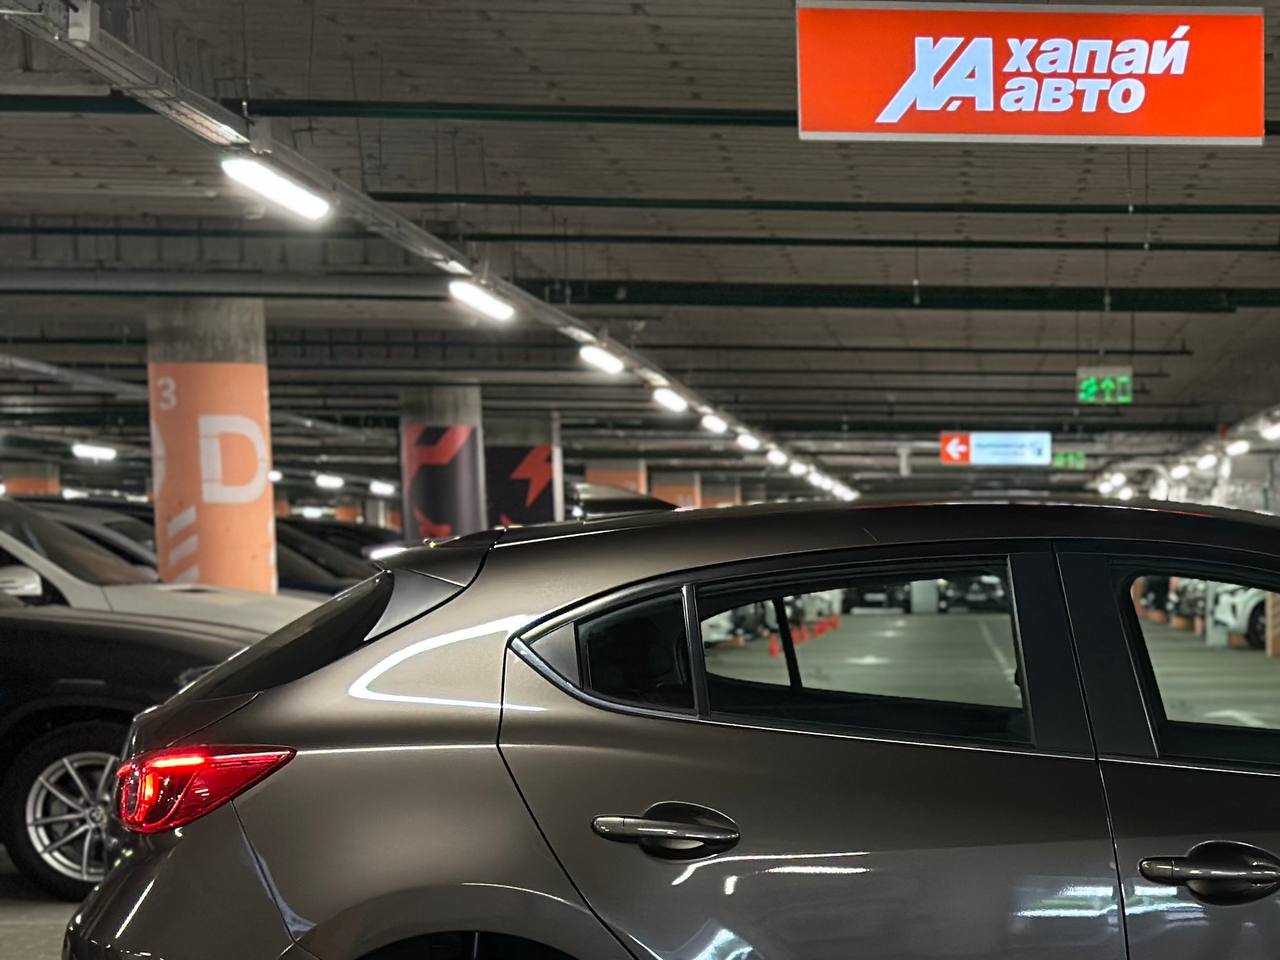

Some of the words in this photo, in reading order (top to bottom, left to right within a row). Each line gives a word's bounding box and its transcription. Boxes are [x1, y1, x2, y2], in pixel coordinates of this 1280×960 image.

[1002, 25, 1190, 75] хапай
[1000, 77, 1146, 113] авто
[158, 376, 177, 412] 3
[197, 414, 266, 504] D
